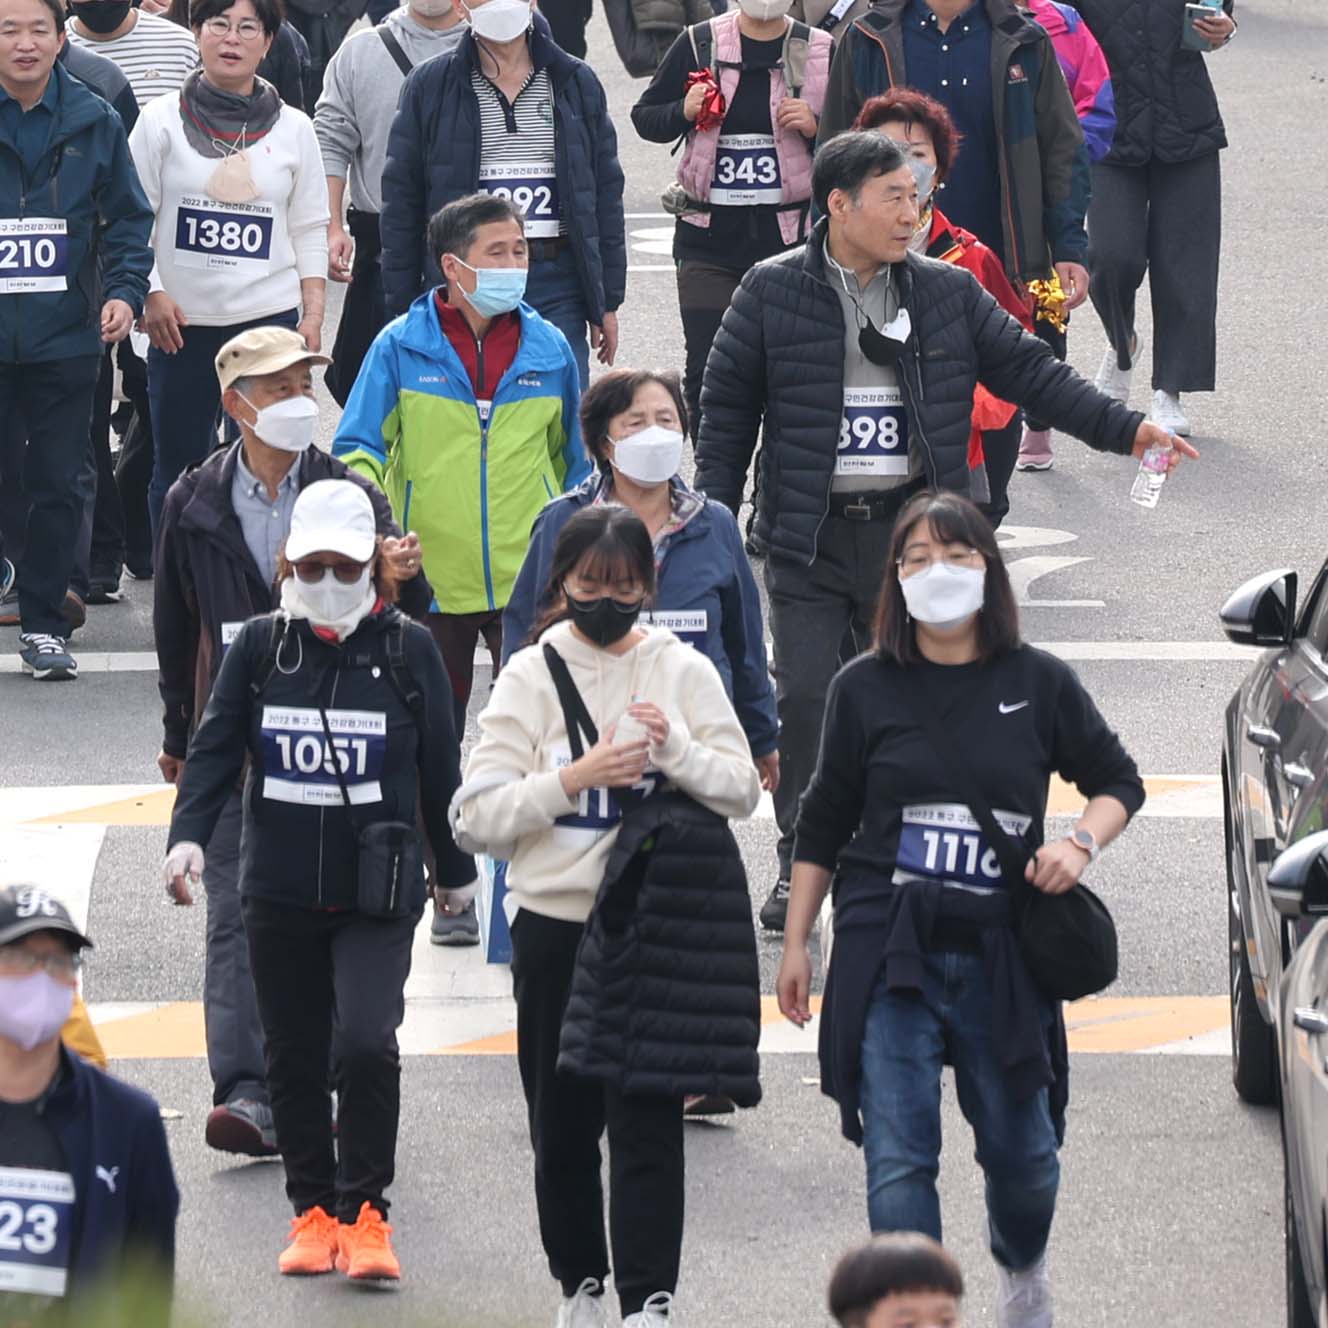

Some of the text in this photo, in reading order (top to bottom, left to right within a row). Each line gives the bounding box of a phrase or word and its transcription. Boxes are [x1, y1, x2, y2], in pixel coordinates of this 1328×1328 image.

[181, 197, 201, 206] 2022
[186, 217, 263, 253] 1380
[275, 734, 367, 775] 1051
